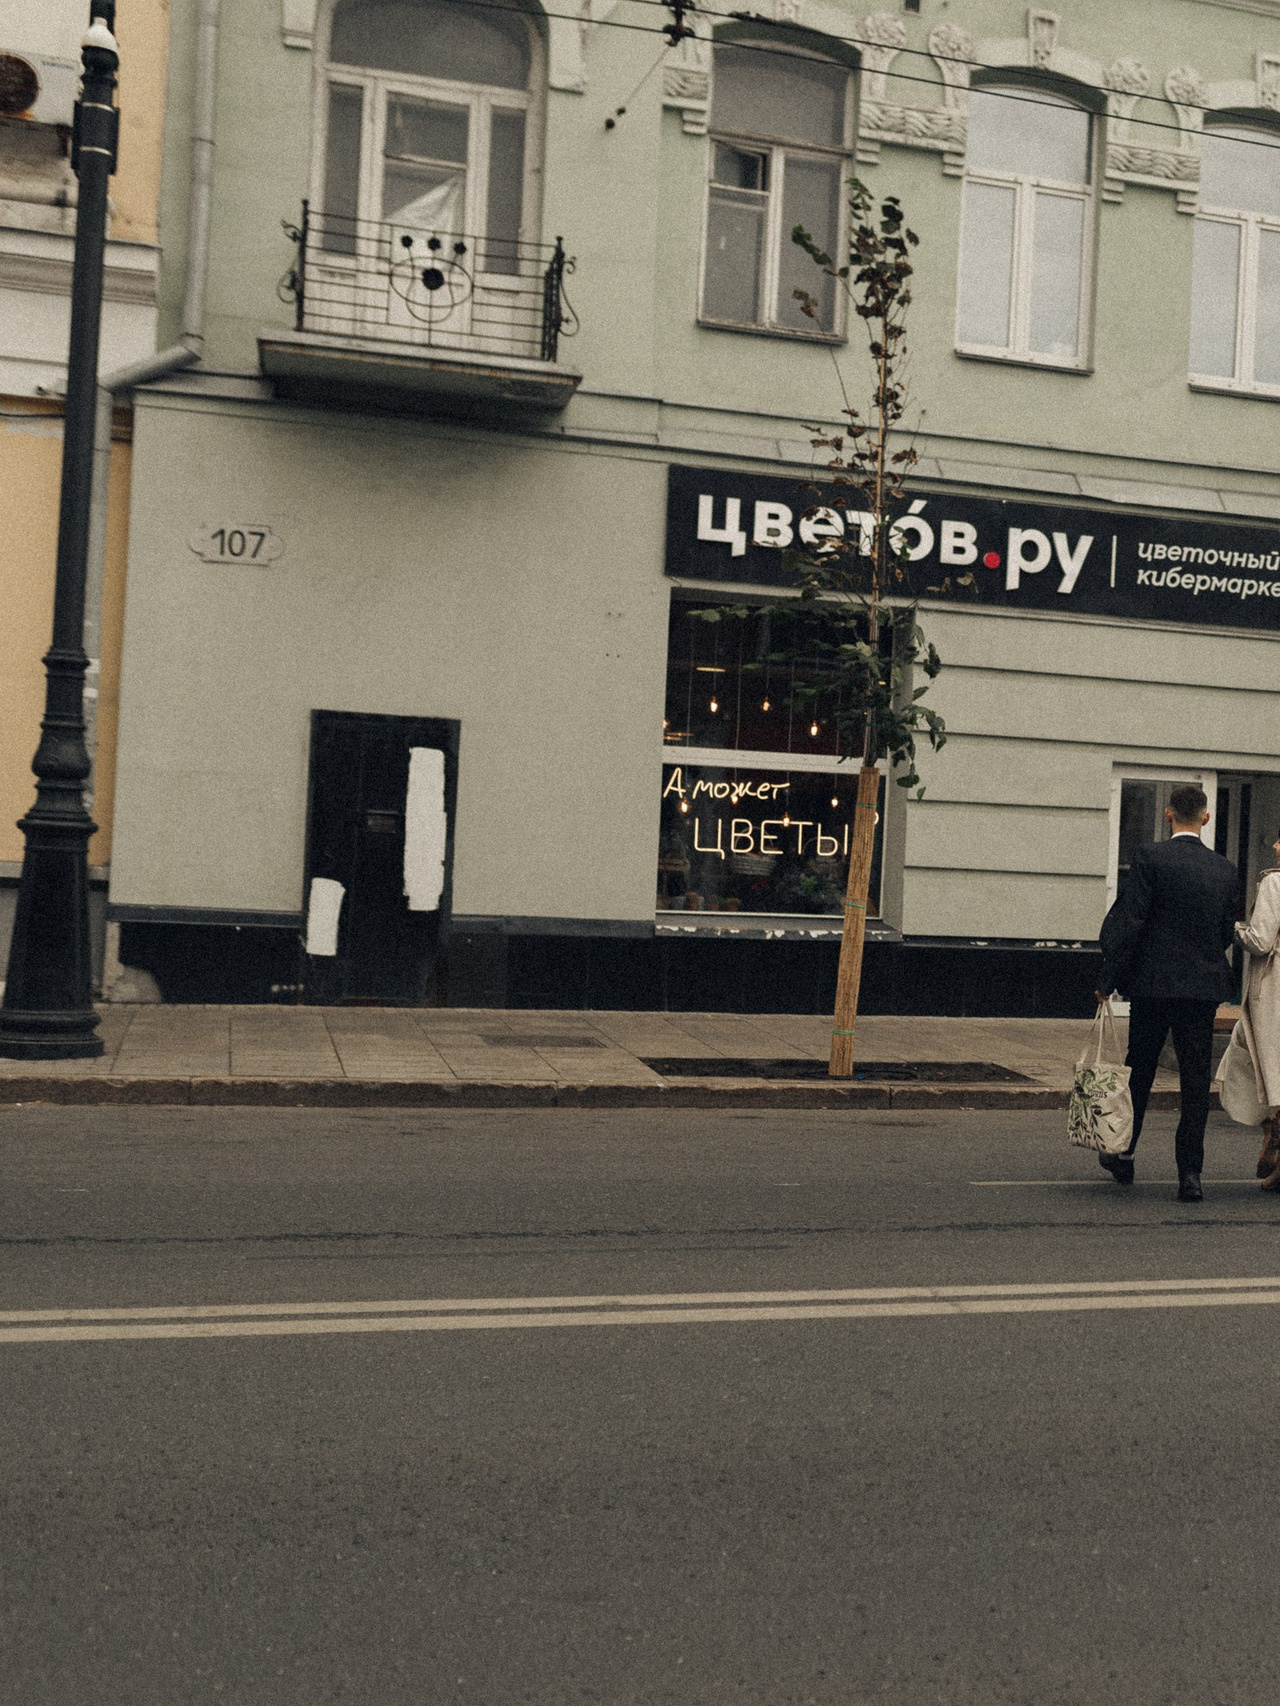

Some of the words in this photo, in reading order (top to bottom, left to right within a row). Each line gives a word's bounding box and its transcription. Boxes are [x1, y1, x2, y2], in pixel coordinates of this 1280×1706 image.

[211, 529, 265, 558] 107
[1137, 541, 1280, 571] цветочный
[663, 767, 687, 798] А
[692, 780, 791, 800] может
[694, 817, 879, 860] ЦВЕТЫ
